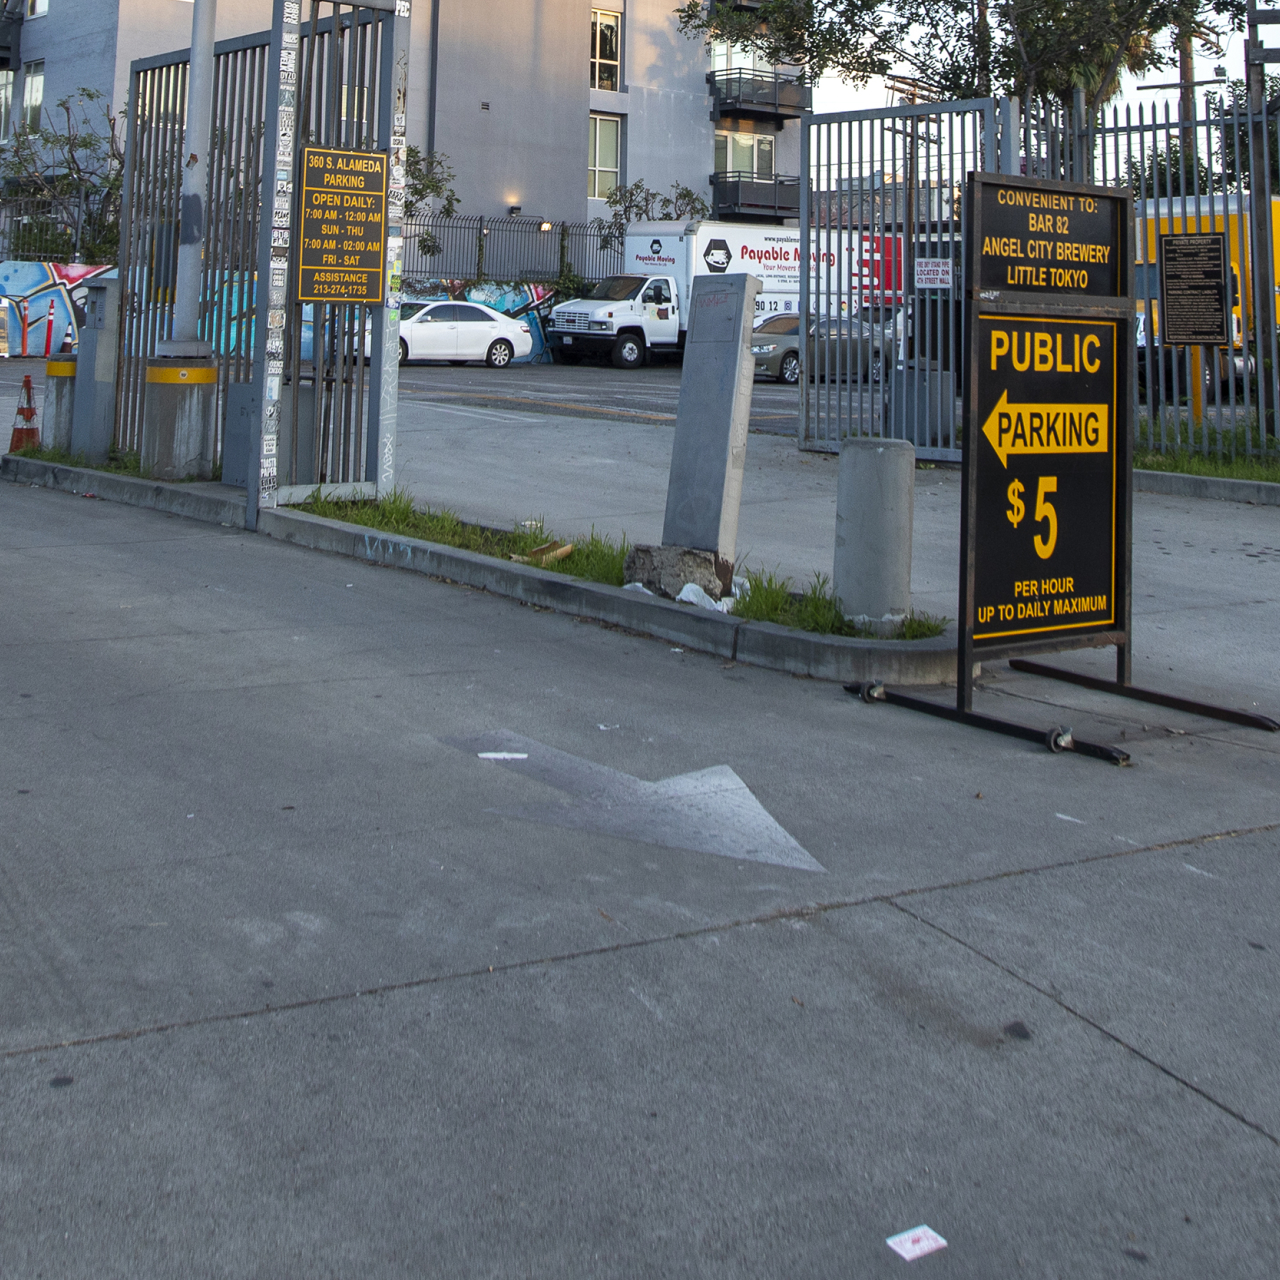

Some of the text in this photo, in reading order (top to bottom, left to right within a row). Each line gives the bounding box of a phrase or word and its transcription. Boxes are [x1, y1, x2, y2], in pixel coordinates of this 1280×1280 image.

[308, 156, 382, 173] 360 S. ALAMEDA
[324, 174, 365, 188] PARKING
[312, 194, 376, 209] OPEN DAILY:
[998, 190, 1098, 214] CONVENIENT TO:
[306, 209, 322, 219] 7:00
[324, 210, 337, 220] AM
[345, 212, 366, 221] 12:00
[368, 212, 381, 222] AM
[1029, 213, 1069, 234] BAR 82
[322, 225, 339, 235] SUN
[346, 226, 364, 236] THU
[304, 239, 322, 249] 7:00
[323, 240, 336, 250] AM
[343, 241, 364, 251] 02:00
[367, 242, 380, 251] AM
[982, 236, 1110, 264] ANGEL CITY BREWERY
[322, 254, 336, 264] FRI
[344, 255, 360, 265] SAT
[741, 245, 790, 264] Payable
[313, 272, 368, 283] ASSISTANCE
[1007, 266, 1088, 288] LITTLE TOKYO
[314, 284, 367, 295] 213-274-1735
[756, 301, 778, 310] 90 12
[991, 330, 1101, 374] PUBLIC
[998, 412, 1100, 448] PARKING
[1006, 476, 1058, 560] $5
[1015, 577, 1074, 597] PER HOUR
[978, 595, 1107, 623] UP TO DAILY MAXIMUM
